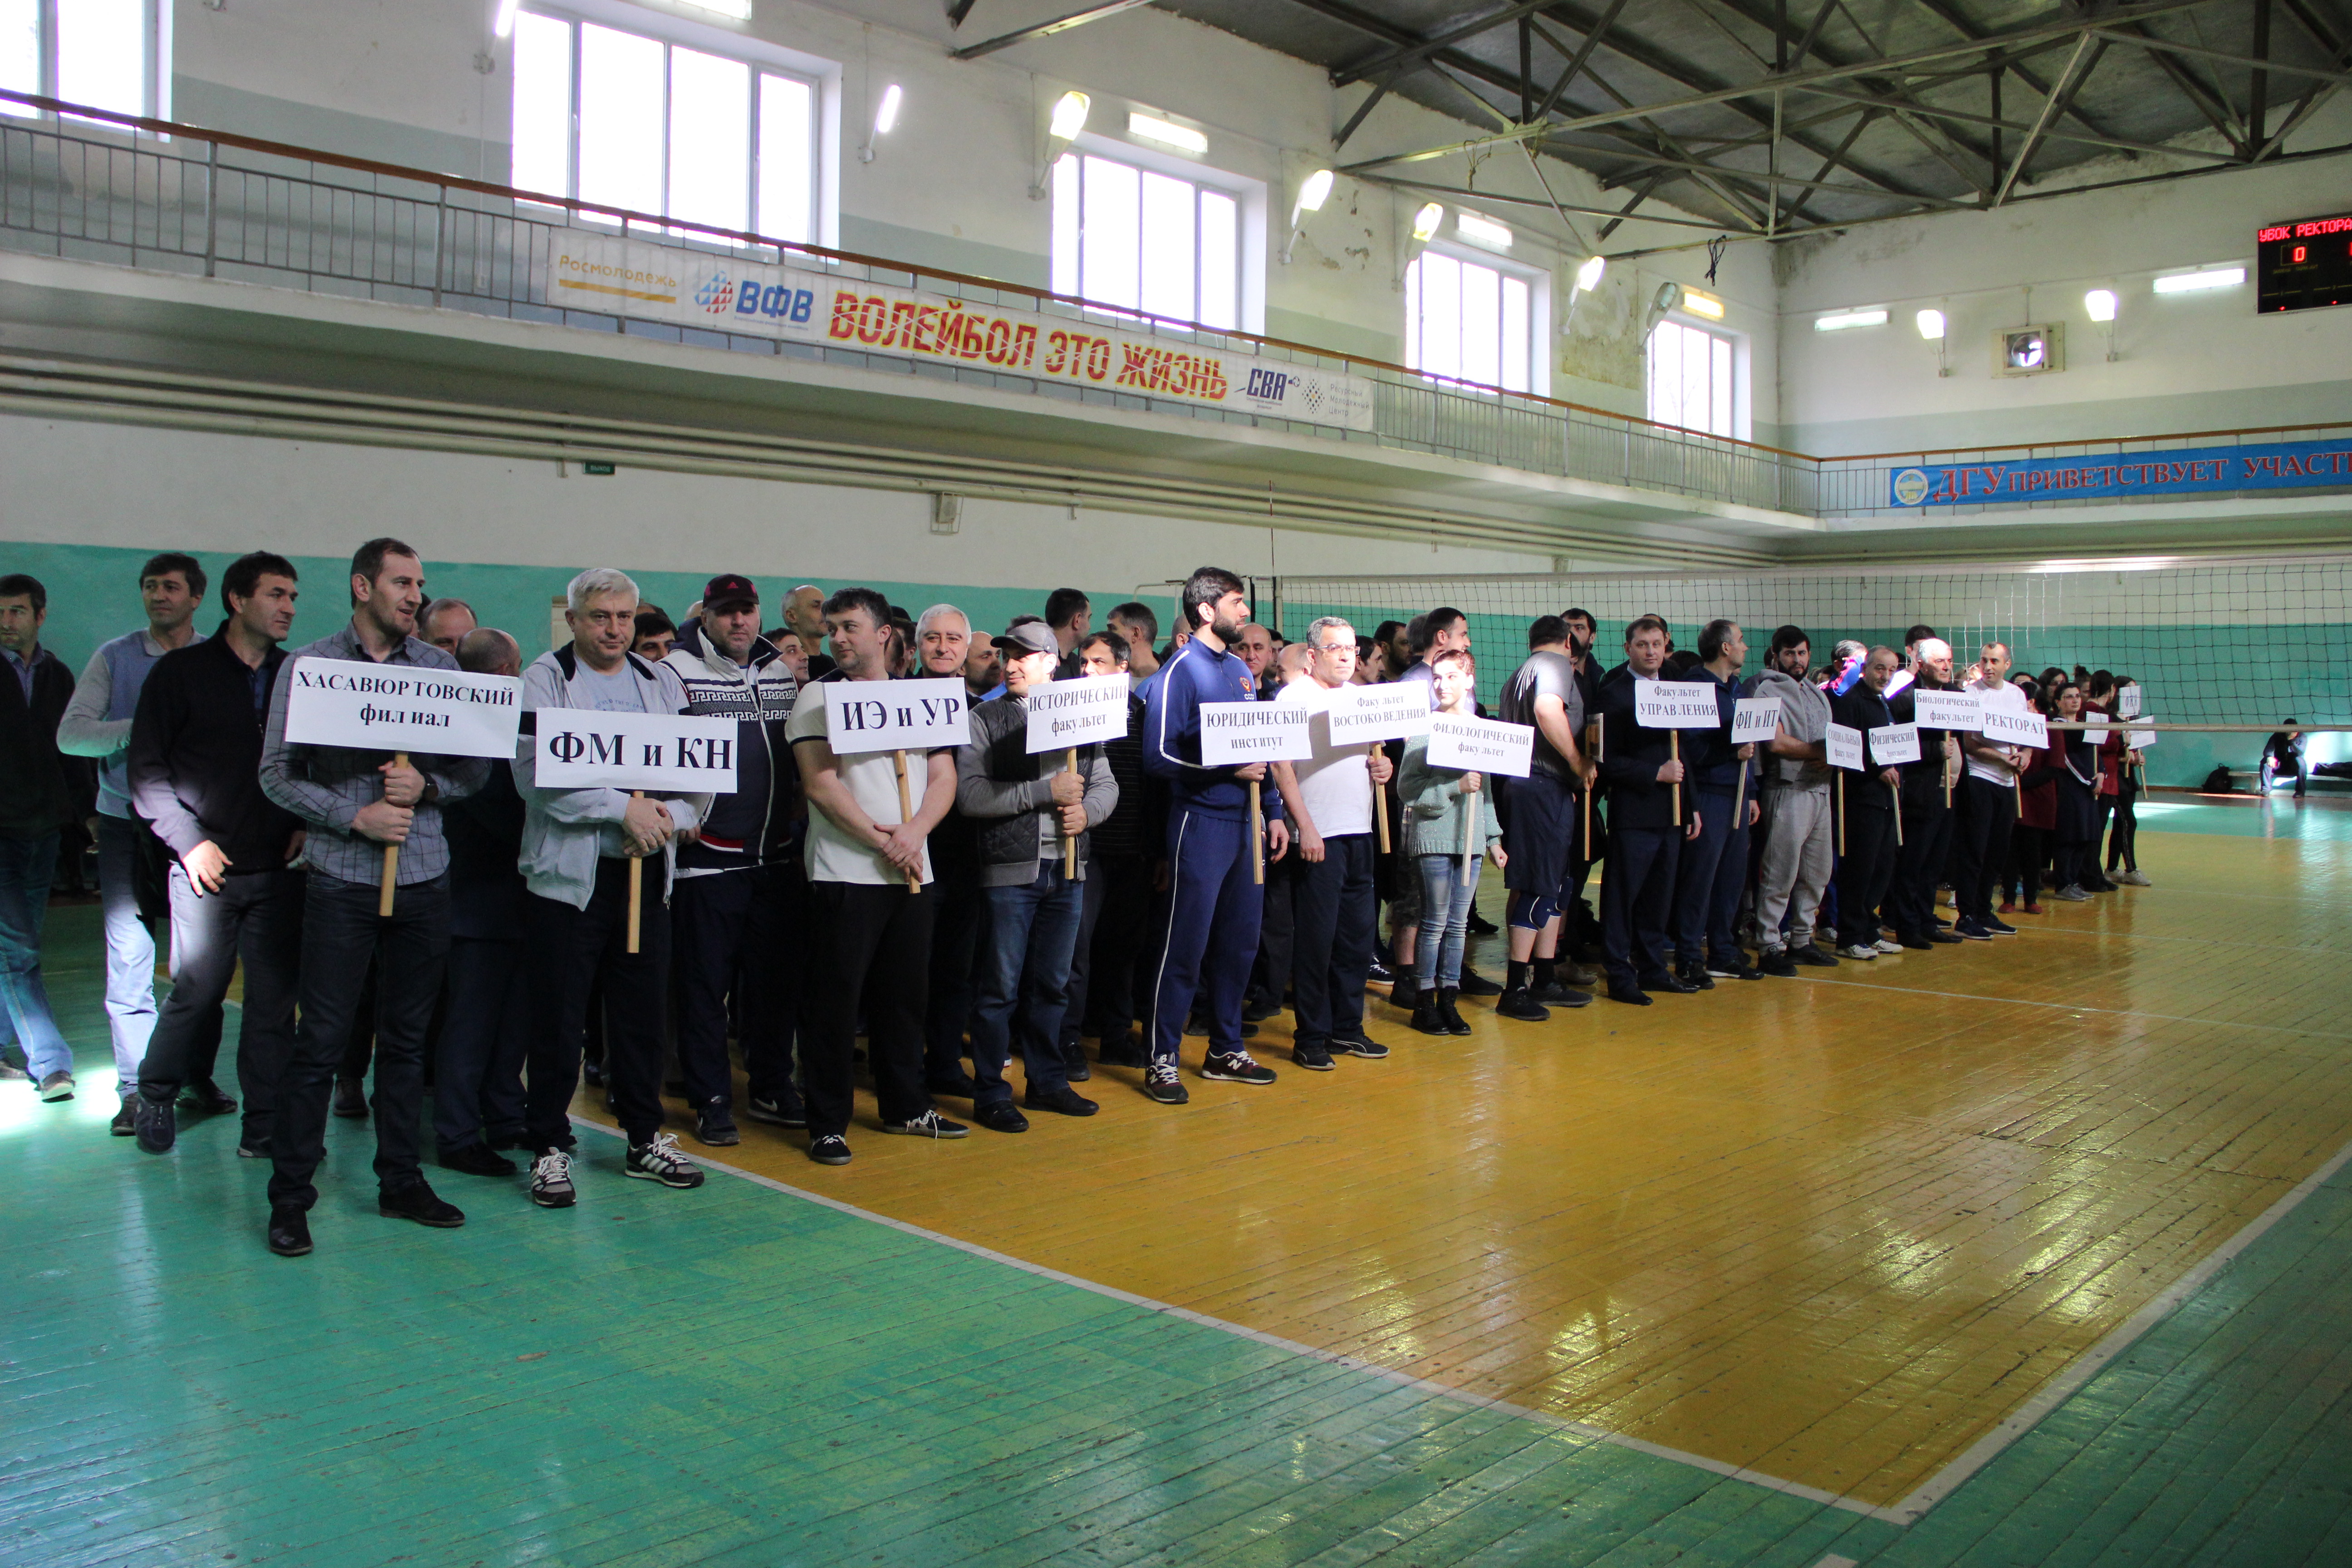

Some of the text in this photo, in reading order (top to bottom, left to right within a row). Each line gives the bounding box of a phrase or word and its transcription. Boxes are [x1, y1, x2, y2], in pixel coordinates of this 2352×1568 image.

[2294, 246, 2306, 262] 0
[559, 255, 676, 287] Росмолодежь
[736, 280, 813, 323] ВФВ
[828, 289, 1229, 402] ВОЛЕЙБОЛ ЭТО ЖИЗНЬ
[1329, 406, 1348, 417] Центр
[1933, 466, 2006, 502] ДГУ
[2008, 459, 2229, 491] ПРИВЕТСТВУЕТ
[1029, 682, 1127, 712] ИСТОРИЧЕСКИЙ
[1654, 686, 1700, 700] Факультет
[1916, 692, 1980, 708] Биологический
[840, 698, 960, 731] ИЭ и УР
[1206, 707, 1308, 730] ЮРИДИЧЕСКИЙ
[1640, 703, 1718, 716] УПРАВЛЕНИЯ
[1736, 710, 1778, 729] ФИ и ИТ
[1930, 710, 1975, 724] факультет
[1052, 714, 1107, 737] факультет
[1433, 722, 1529, 746] ФИЛОЛОГИЧЕСКИЙ
[1985, 712, 2045, 735] РЕКТОРАТ
[1869, 728, 1915, 745] Физический
[549, 731, 734, 770] ФМ и КН
